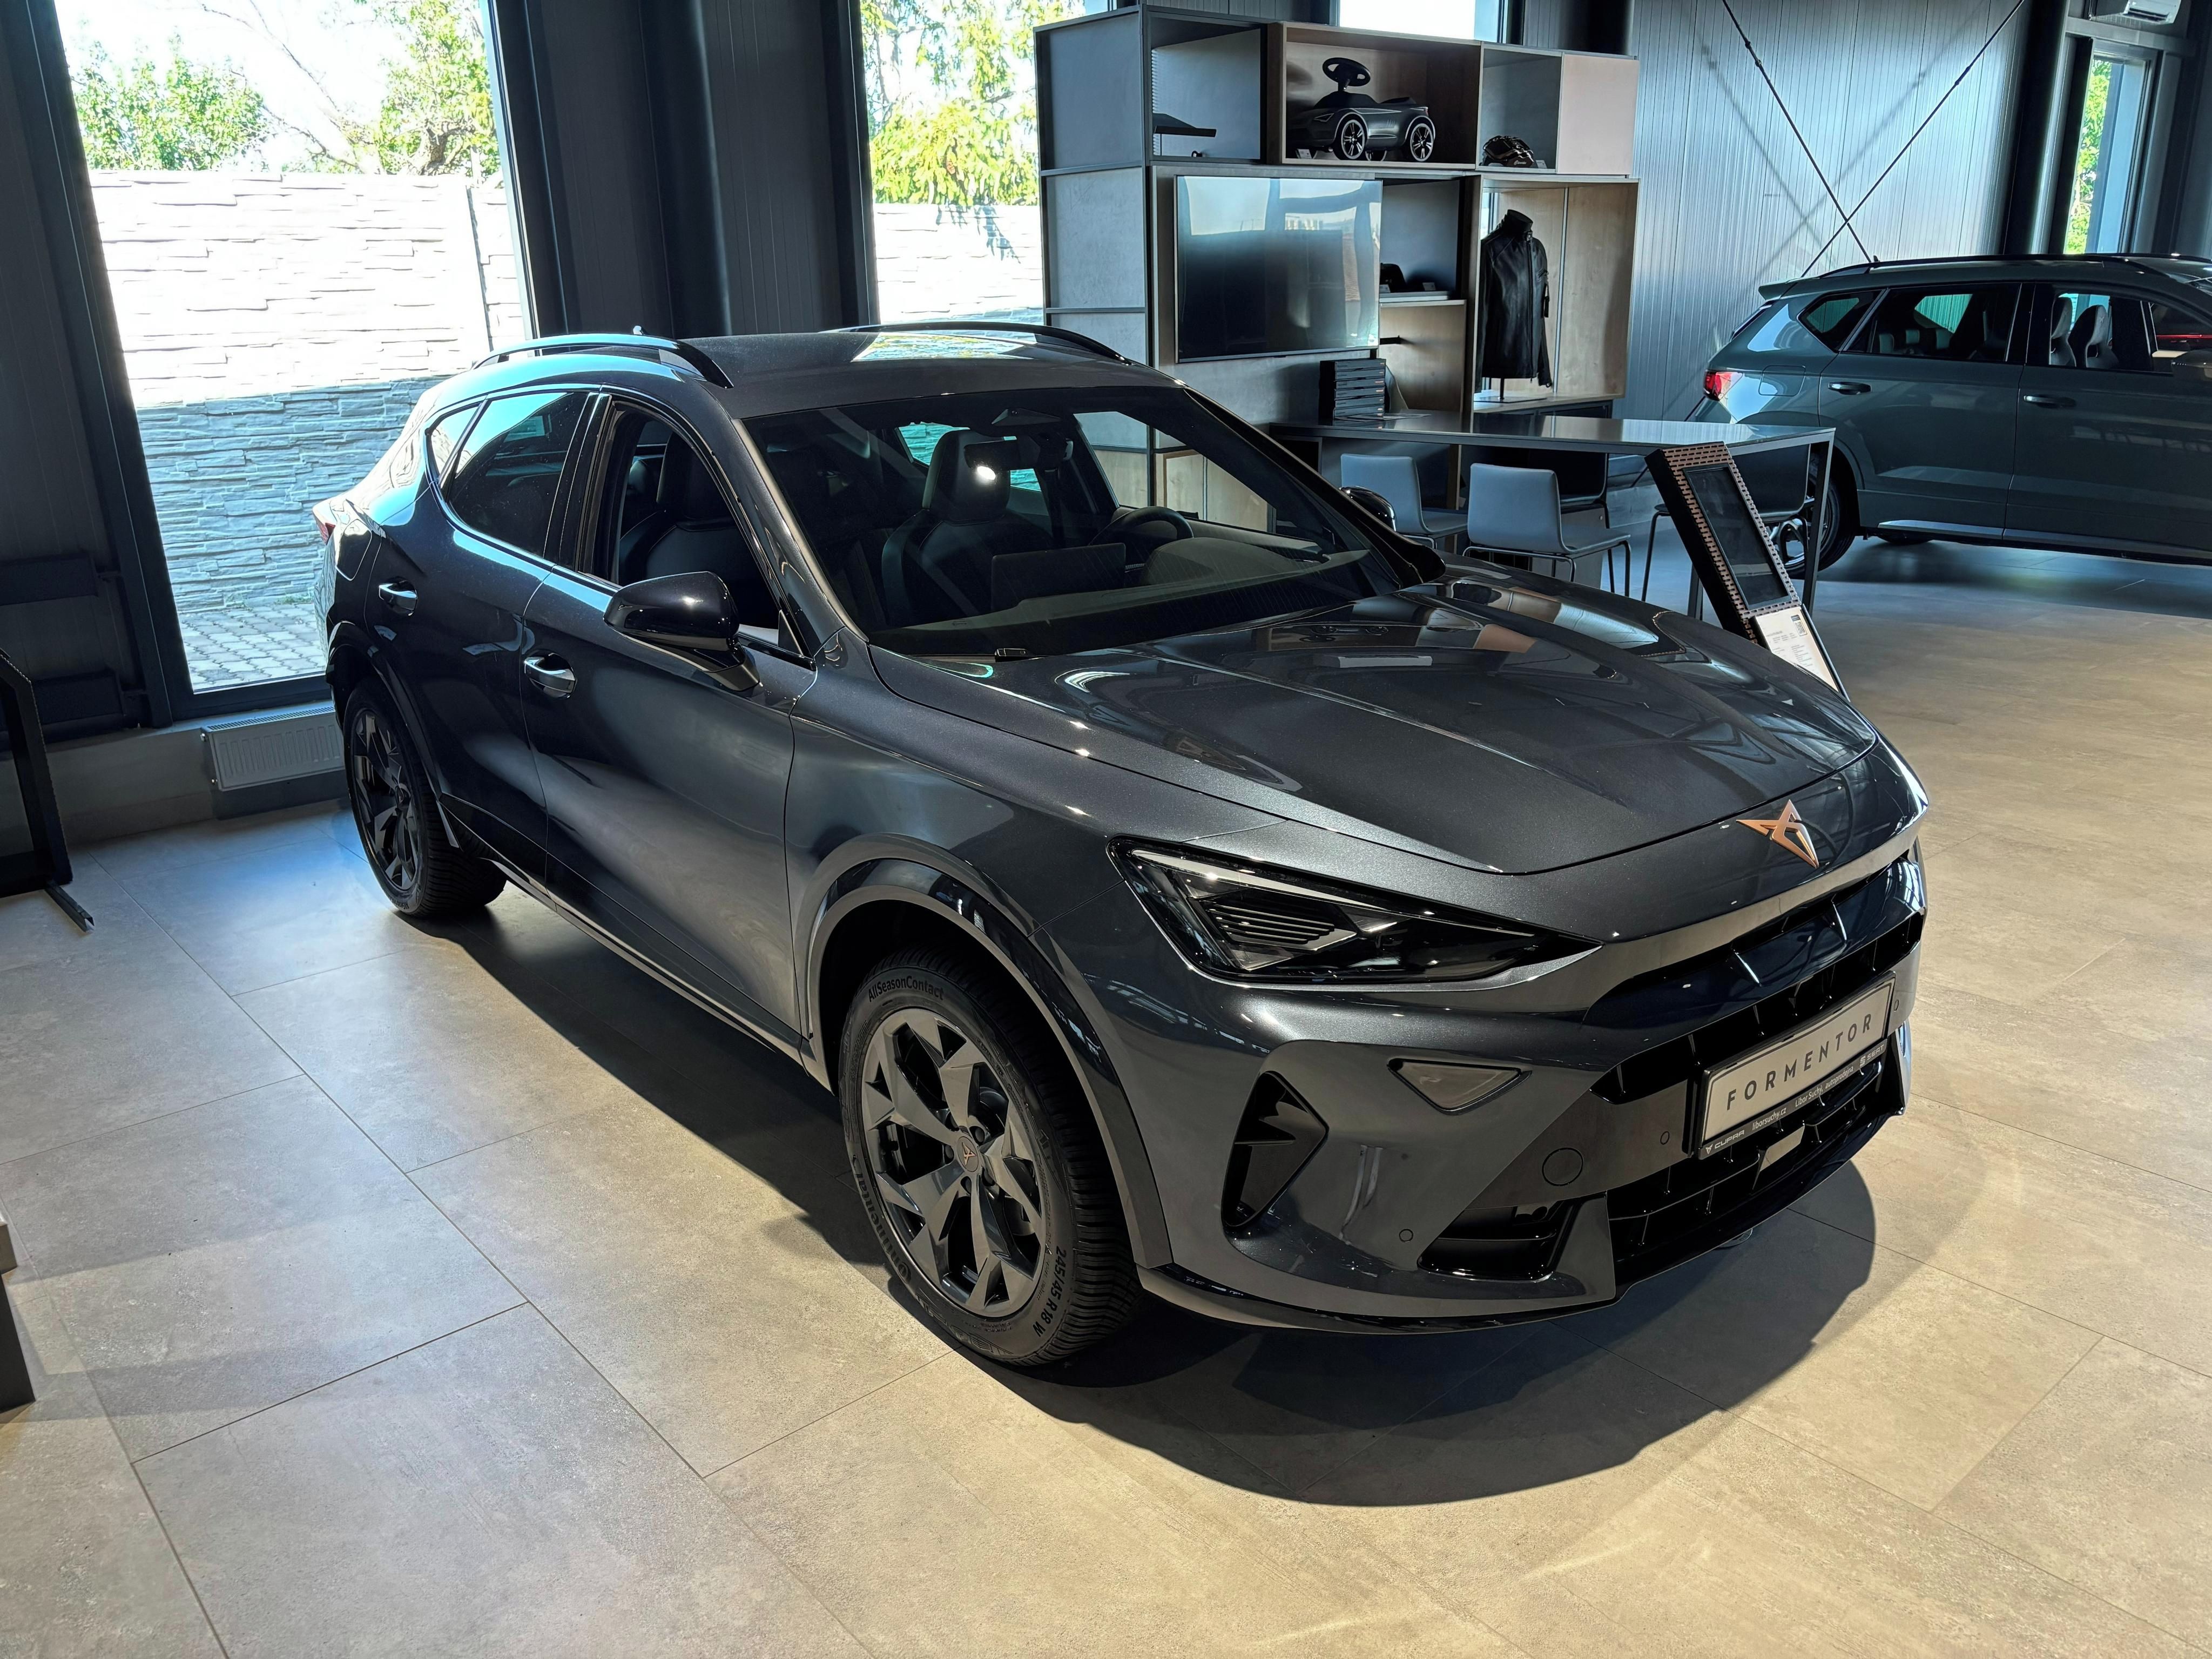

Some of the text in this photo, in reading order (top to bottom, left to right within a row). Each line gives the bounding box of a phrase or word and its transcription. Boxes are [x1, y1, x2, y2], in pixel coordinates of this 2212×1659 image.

[868, 975, 945, 1002] AllSeasonContact
[1727, 1014, 1872, 1111] FORMENTOR
[1867, 1044, 1884, 1060] SEAT
[1795, 1094, 1809, 1107] Libor
[1825, 1066, 1853, 1089] autoprodejna
[1752, 1108, 1787, 1130] liborsuchy.cz
[1714, 1130, 1745, 1149] CUPRA
[1050, 1245, 1067, 1300] 245/45
[1033, 1321, 1046, 1337] W
